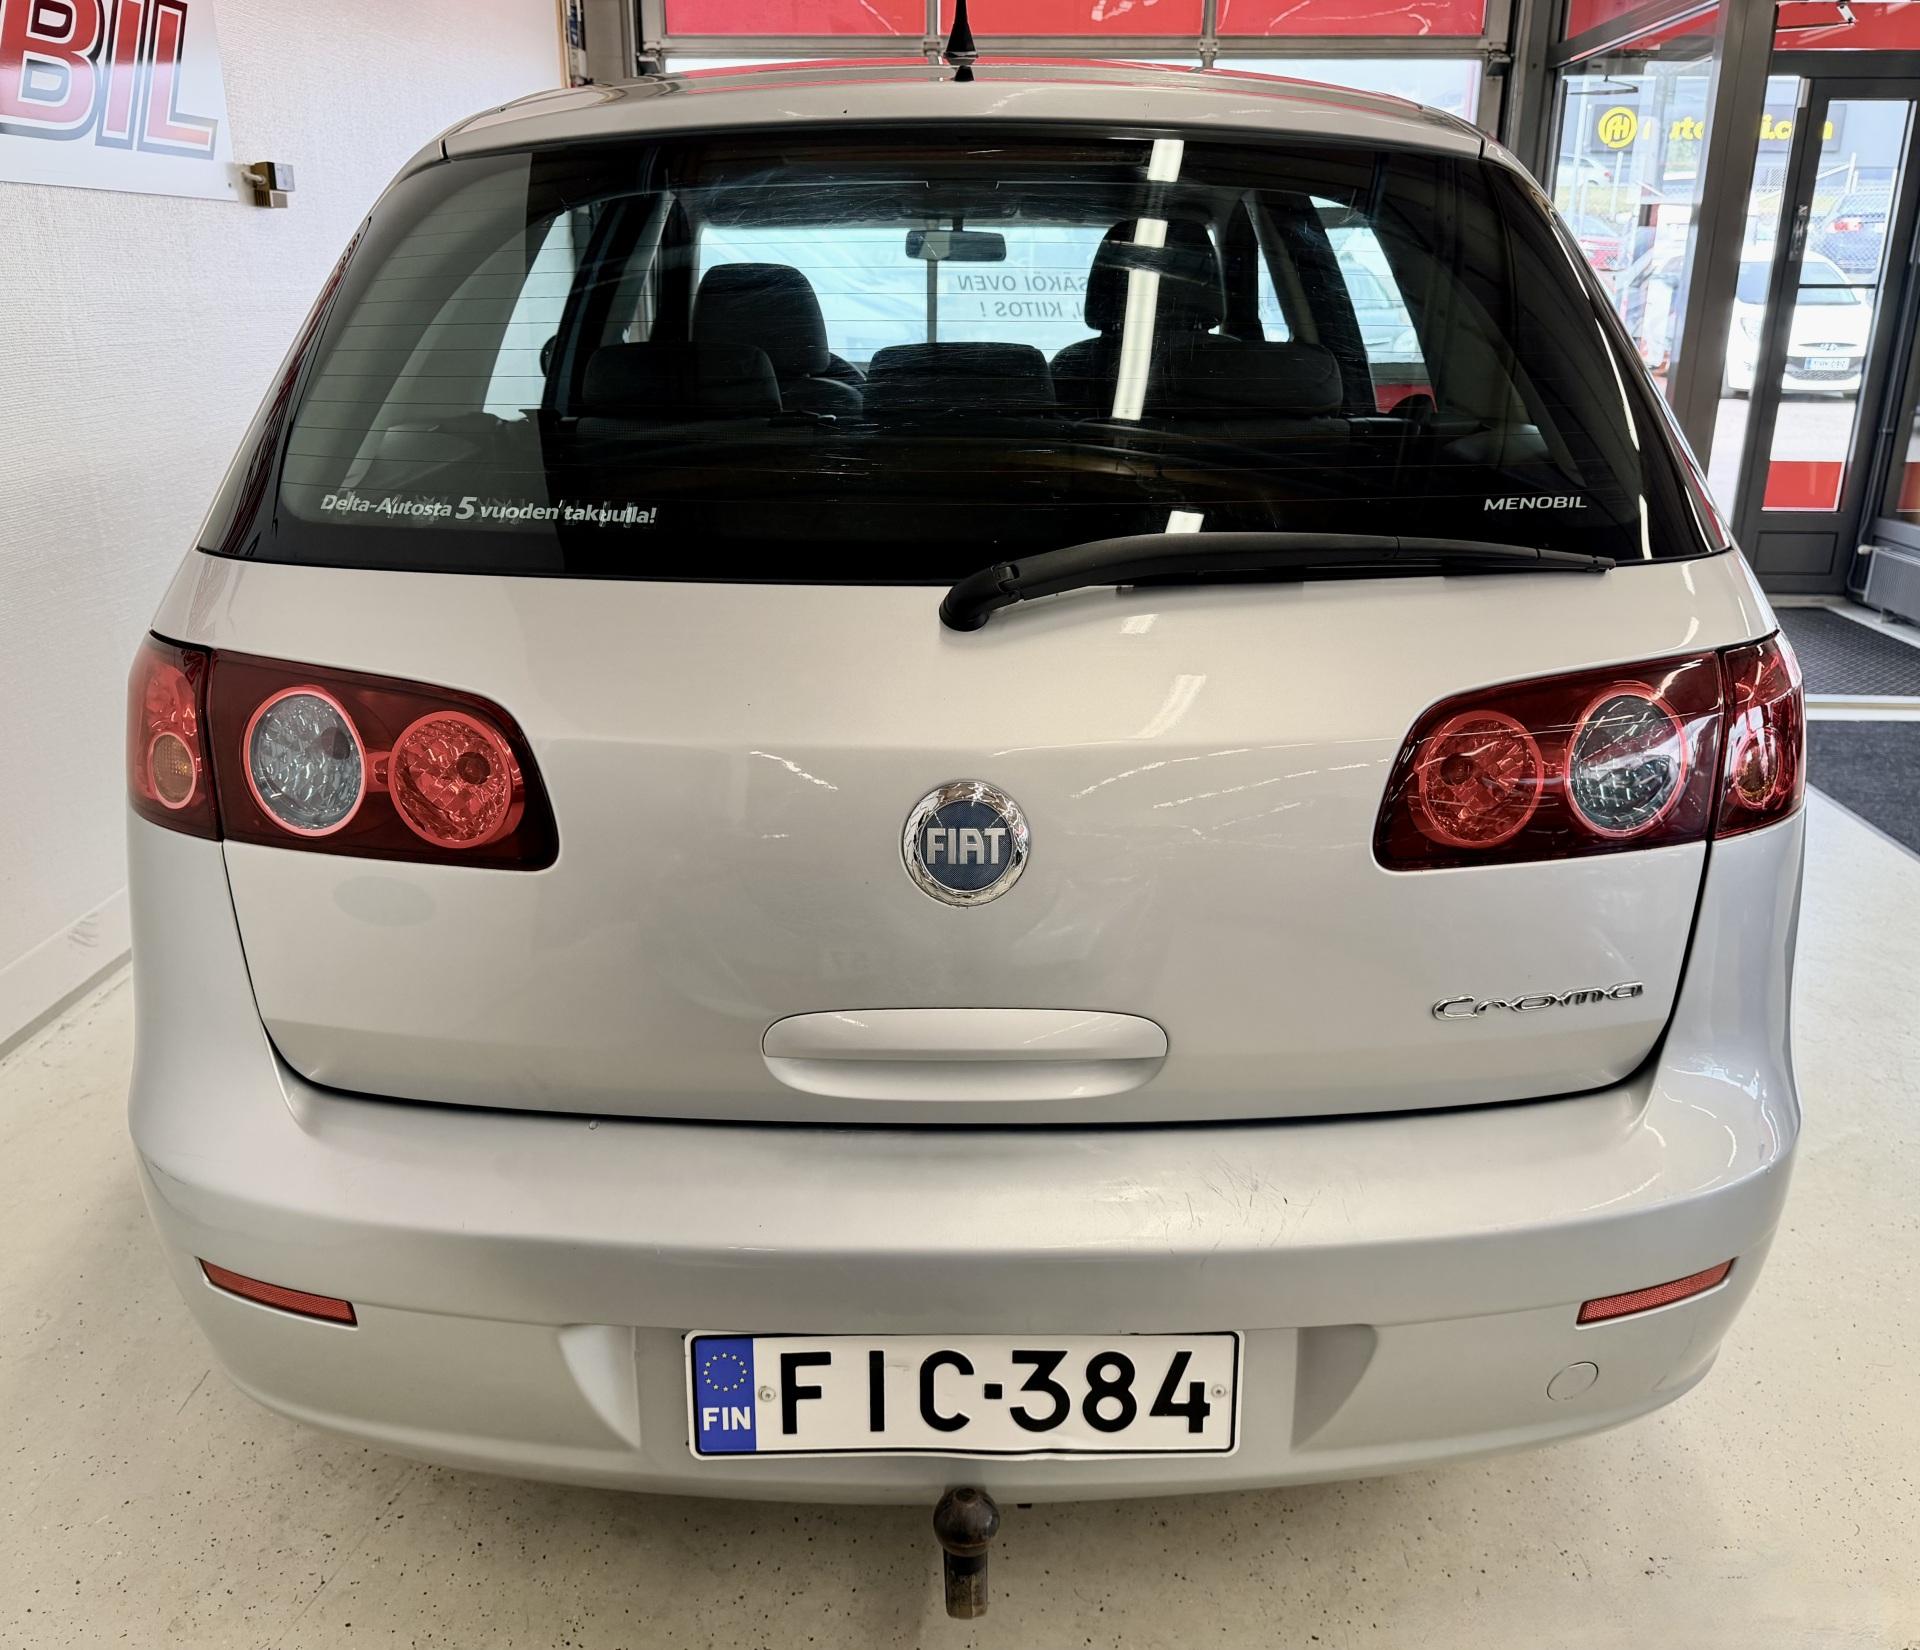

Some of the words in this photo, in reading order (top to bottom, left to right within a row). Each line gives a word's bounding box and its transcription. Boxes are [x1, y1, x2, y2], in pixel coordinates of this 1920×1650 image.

[320, 494, 452, 518] Delta-Autosta
[455, 496, 478, 519] 5
[480, 501, 559, 520] vuoden
[564, 502, 657, 523] takuulla!
[1483, 496, 1588, 511] MENOBIL
[926, 827, 1006, 865] FIAT
[1431, 981, 1643, 1021] Croma
[780, 1349, 1211, 1434] FIC-384
[702, 1406, 752, 1431] FIN
